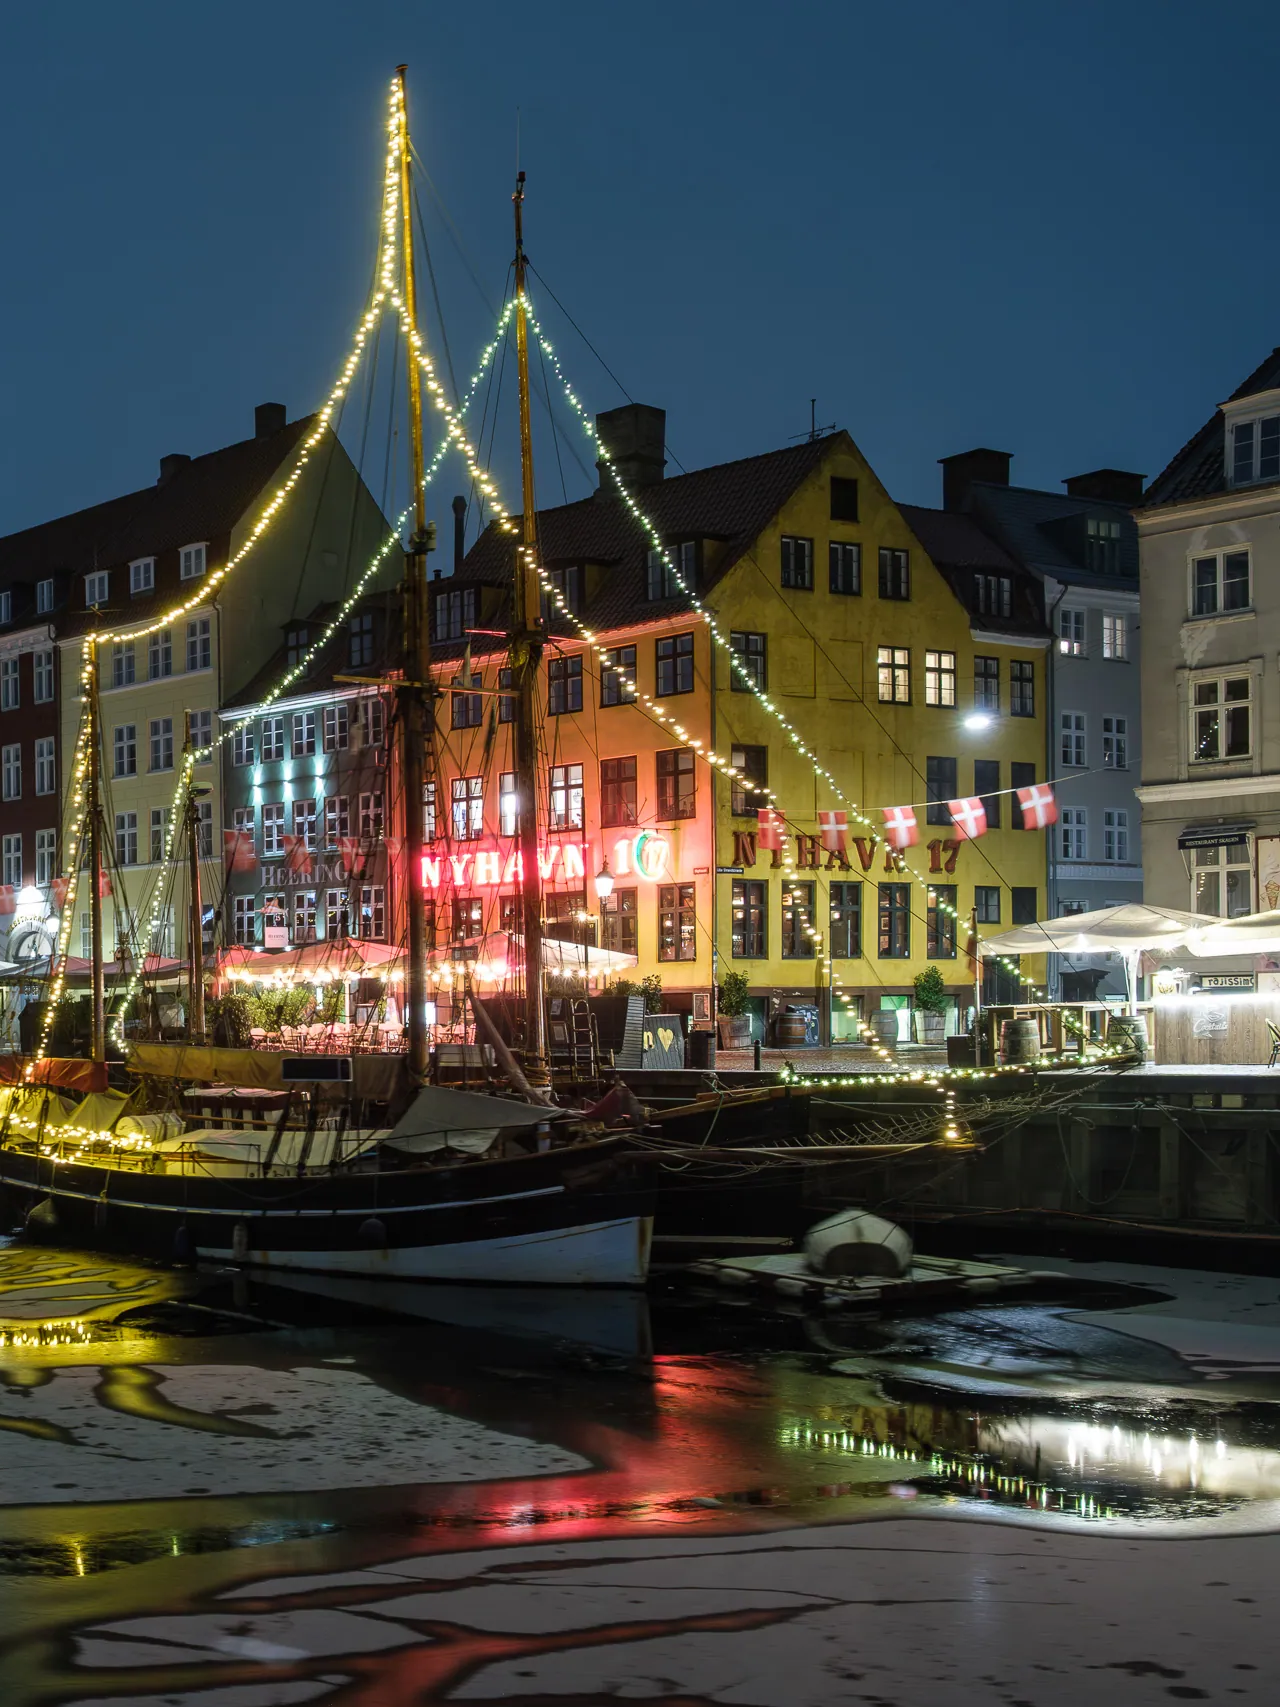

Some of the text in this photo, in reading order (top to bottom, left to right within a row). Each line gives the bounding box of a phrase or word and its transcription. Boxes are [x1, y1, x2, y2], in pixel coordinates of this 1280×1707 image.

[1185, 838, 1218, 847] RESTAURANT
[421, 844, 585, 887] NYHAVN
[927, 839, 961, 875] 17
[260, 860, 348, 888] HEERING
[5, 916, 47, 937] RESTAURAN
